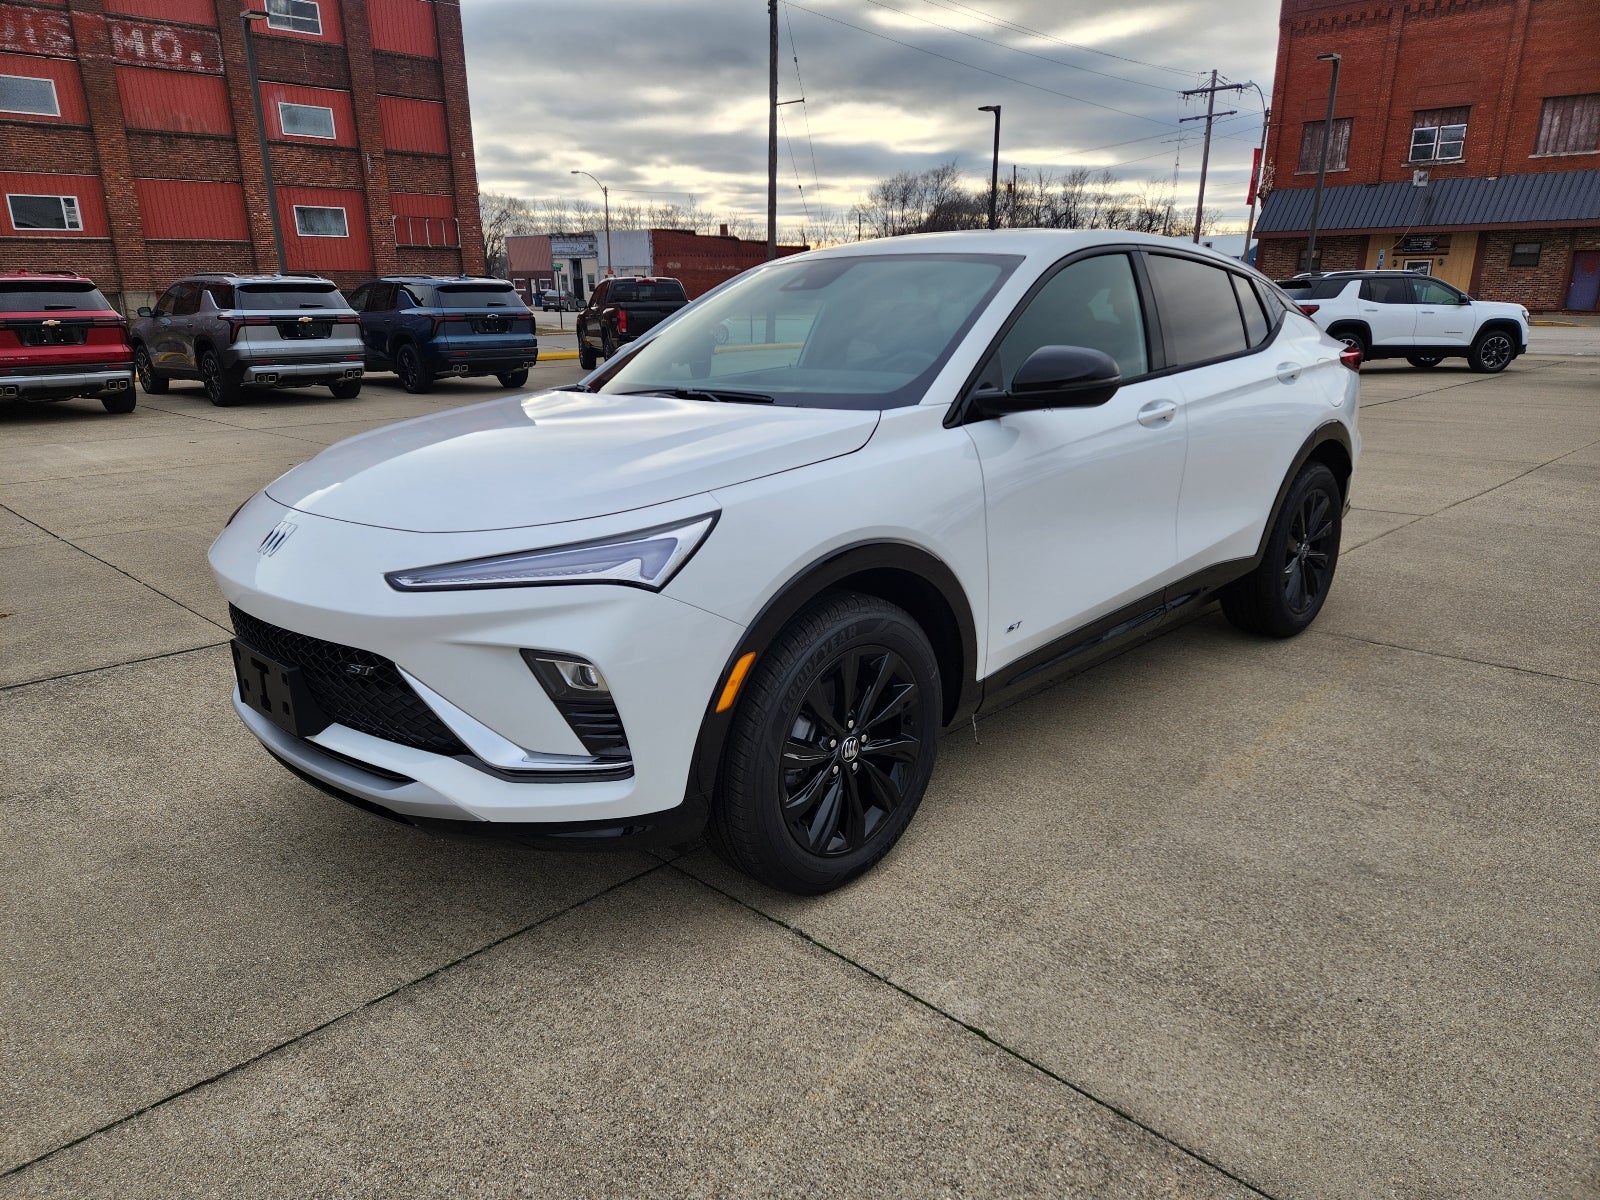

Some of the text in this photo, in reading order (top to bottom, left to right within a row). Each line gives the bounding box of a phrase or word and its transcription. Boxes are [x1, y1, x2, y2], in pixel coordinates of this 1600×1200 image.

[111, 25, 202, 63] MO.
[346, 663, 374, 676] ST
[782, 624, 857, 713] GOODYEAR
